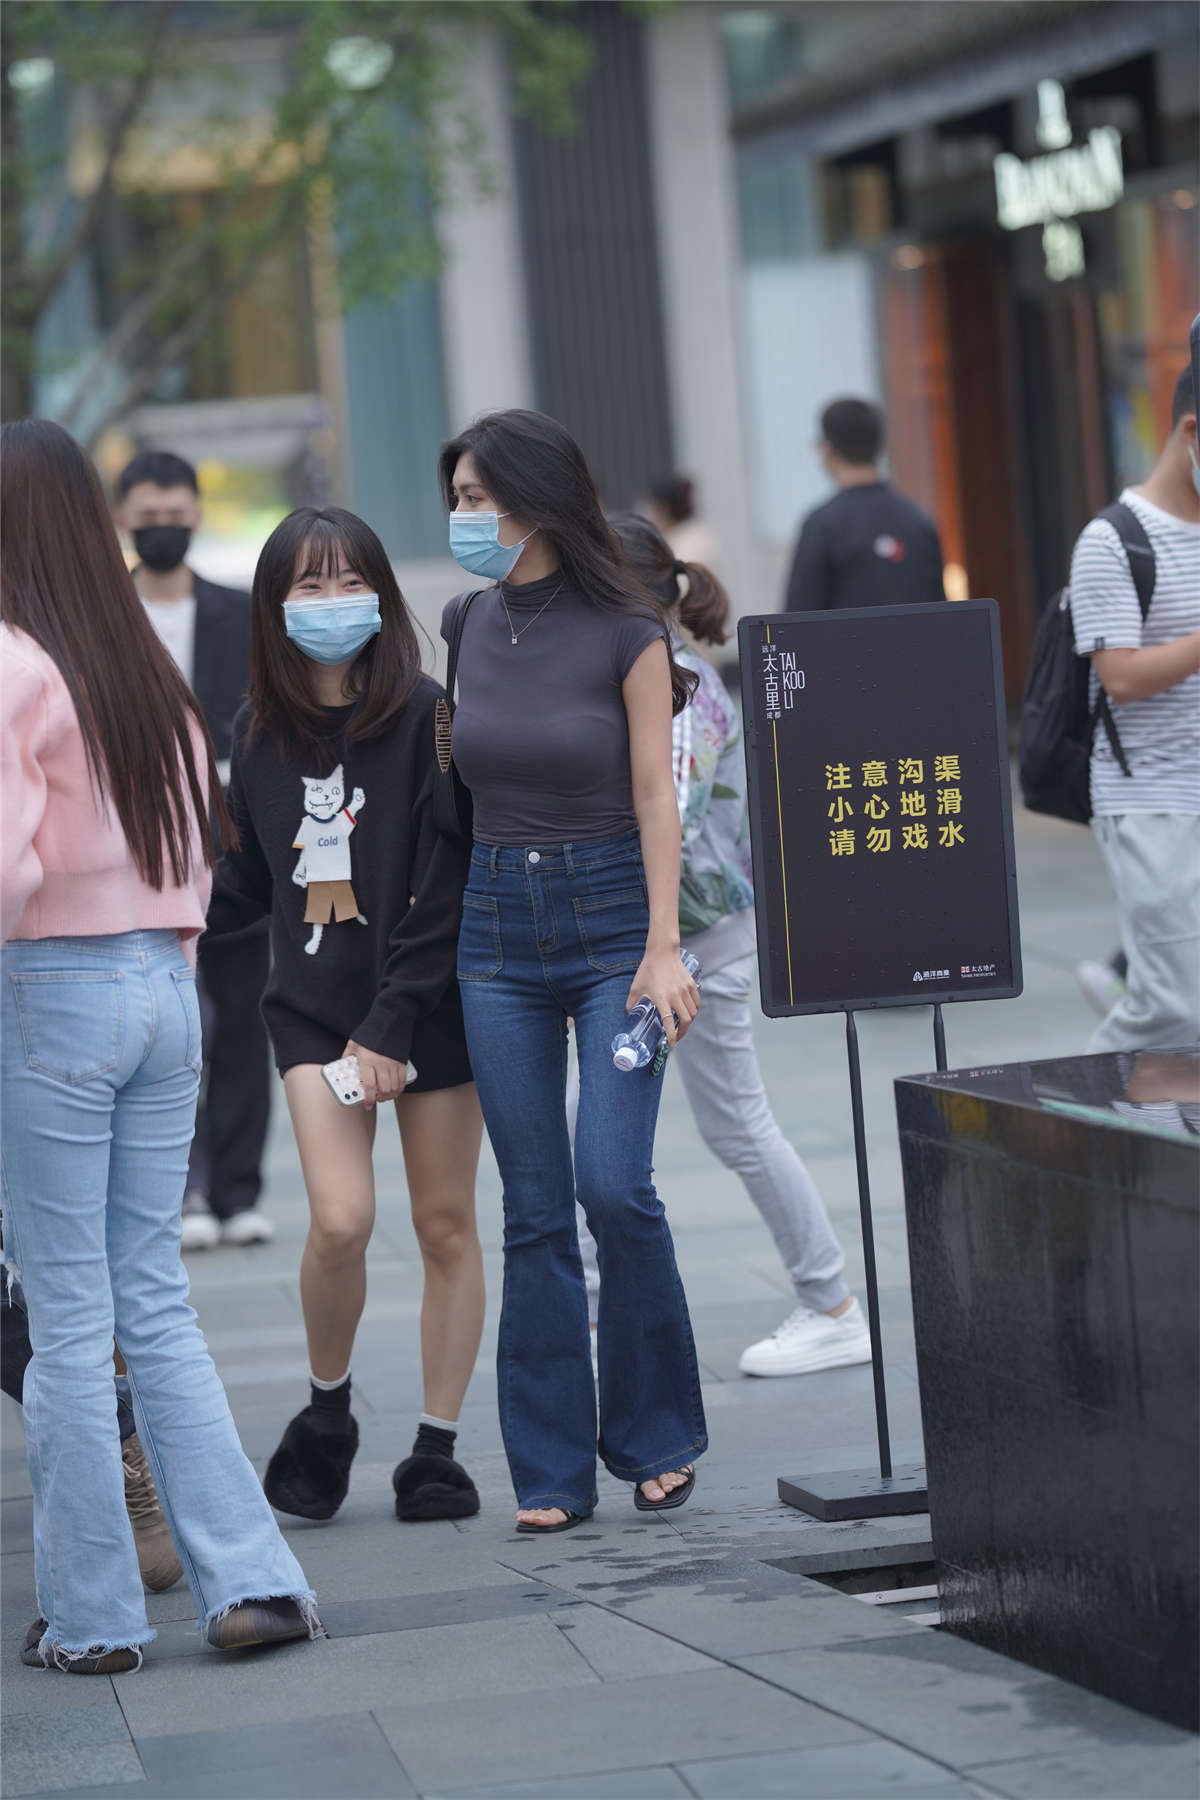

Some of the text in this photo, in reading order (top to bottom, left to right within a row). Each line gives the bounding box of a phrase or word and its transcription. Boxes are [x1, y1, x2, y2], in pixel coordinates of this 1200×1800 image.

[779, 652, 796, 671] TAI
[763, 654, 781, 711] 太古里
[782, 670, 805, 690] KOO
[784, 690, 794, 709] LI
[825, 755, 961, 791] 注意沟渠
[827, 788, 962, 823] 小心地滑
[318, 836, 338, 847] Cold
[829, 820, 965, 856] 请勿戏水
